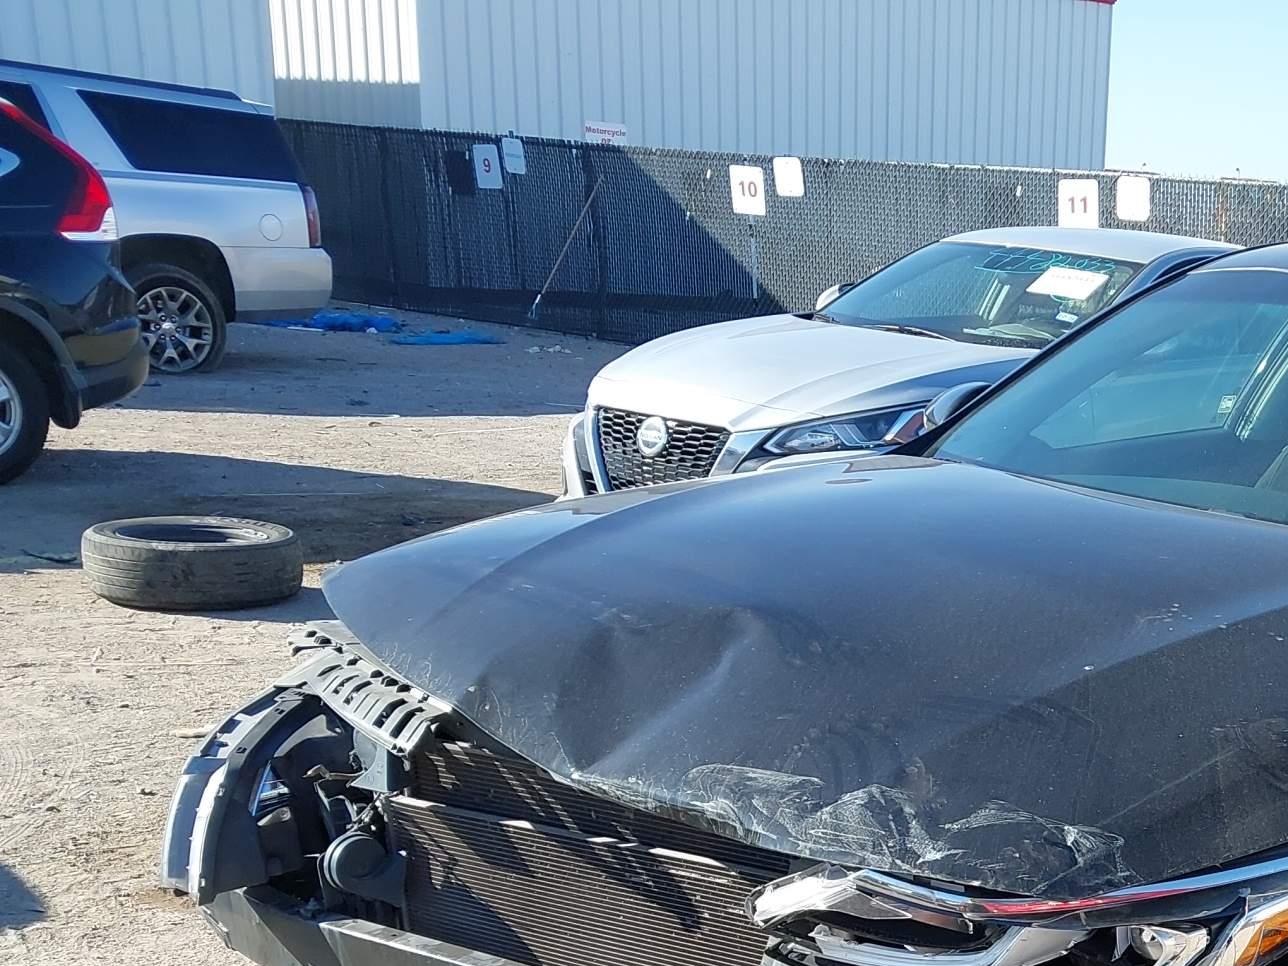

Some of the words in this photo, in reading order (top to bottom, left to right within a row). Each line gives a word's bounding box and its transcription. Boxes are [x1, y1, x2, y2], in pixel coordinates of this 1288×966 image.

[585, 126, 626, 137] Motorcycle
[483, 158, 491, 173] 9
[738, 180, 757, 197] 10
[1067, 195, 1088, 213] 11
